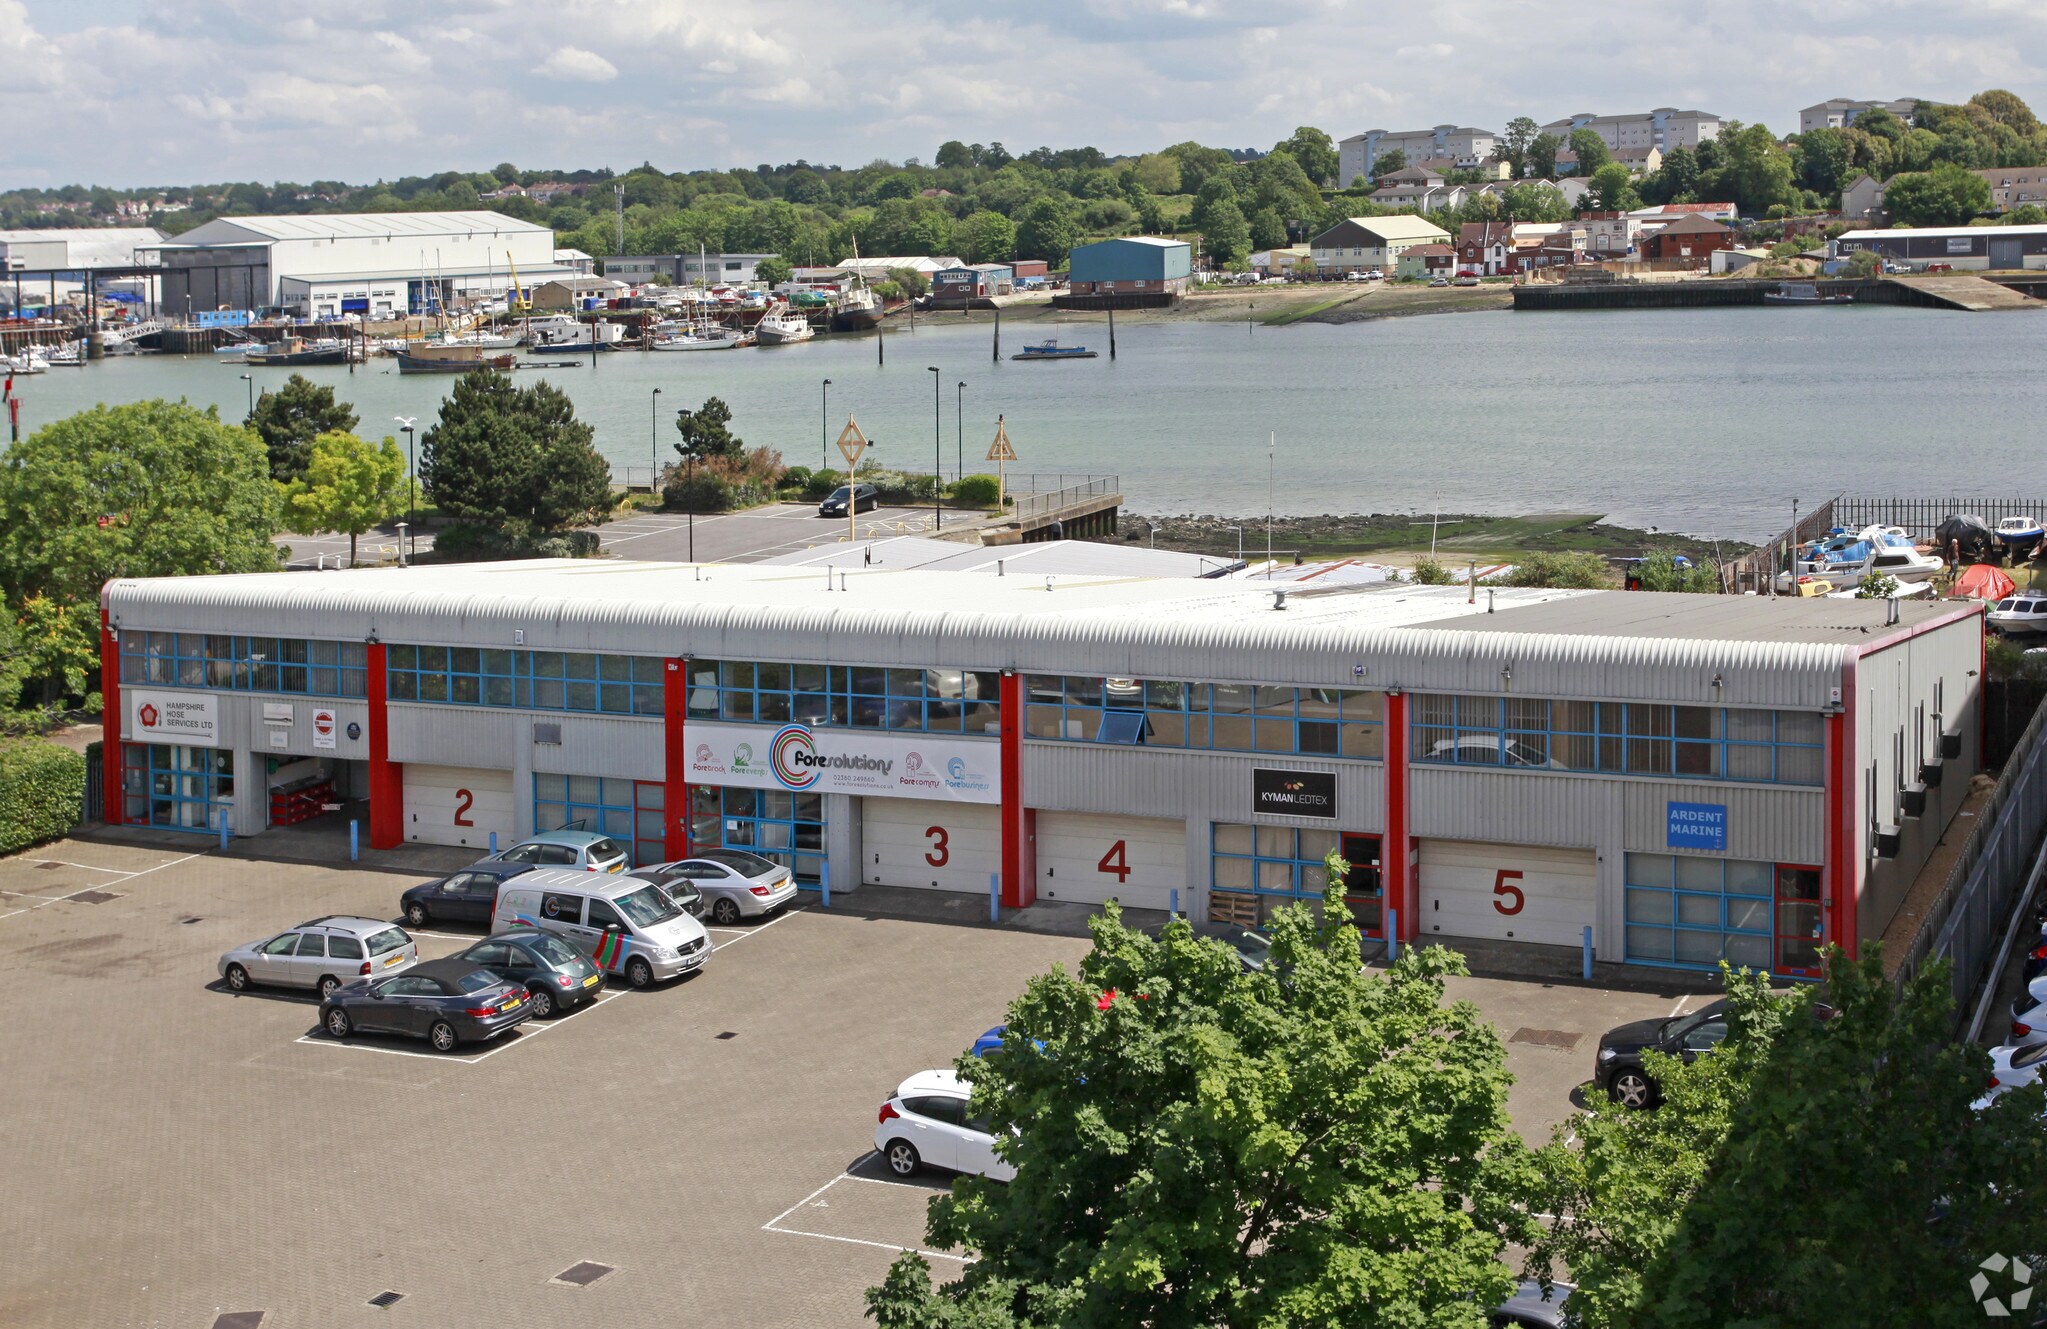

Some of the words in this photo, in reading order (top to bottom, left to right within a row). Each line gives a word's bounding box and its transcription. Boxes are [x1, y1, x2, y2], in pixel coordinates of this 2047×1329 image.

[166, 702, 205, 711] HAMPSHIRE
[166, 710, 185, 718] HOSE
[166, 719, 199, 728] SERVICES
[201, 721, 213, 729] LTD
[454, 788, 474, 828] 2
[1670, 809, 1723, 823] ARDENT
[1670, 823, 1722, 837] MARINE
[925, 826, 949, 867] 3
[1098, 840, 1131, 883] 4
[1493, 869, 1525, 916] 5
